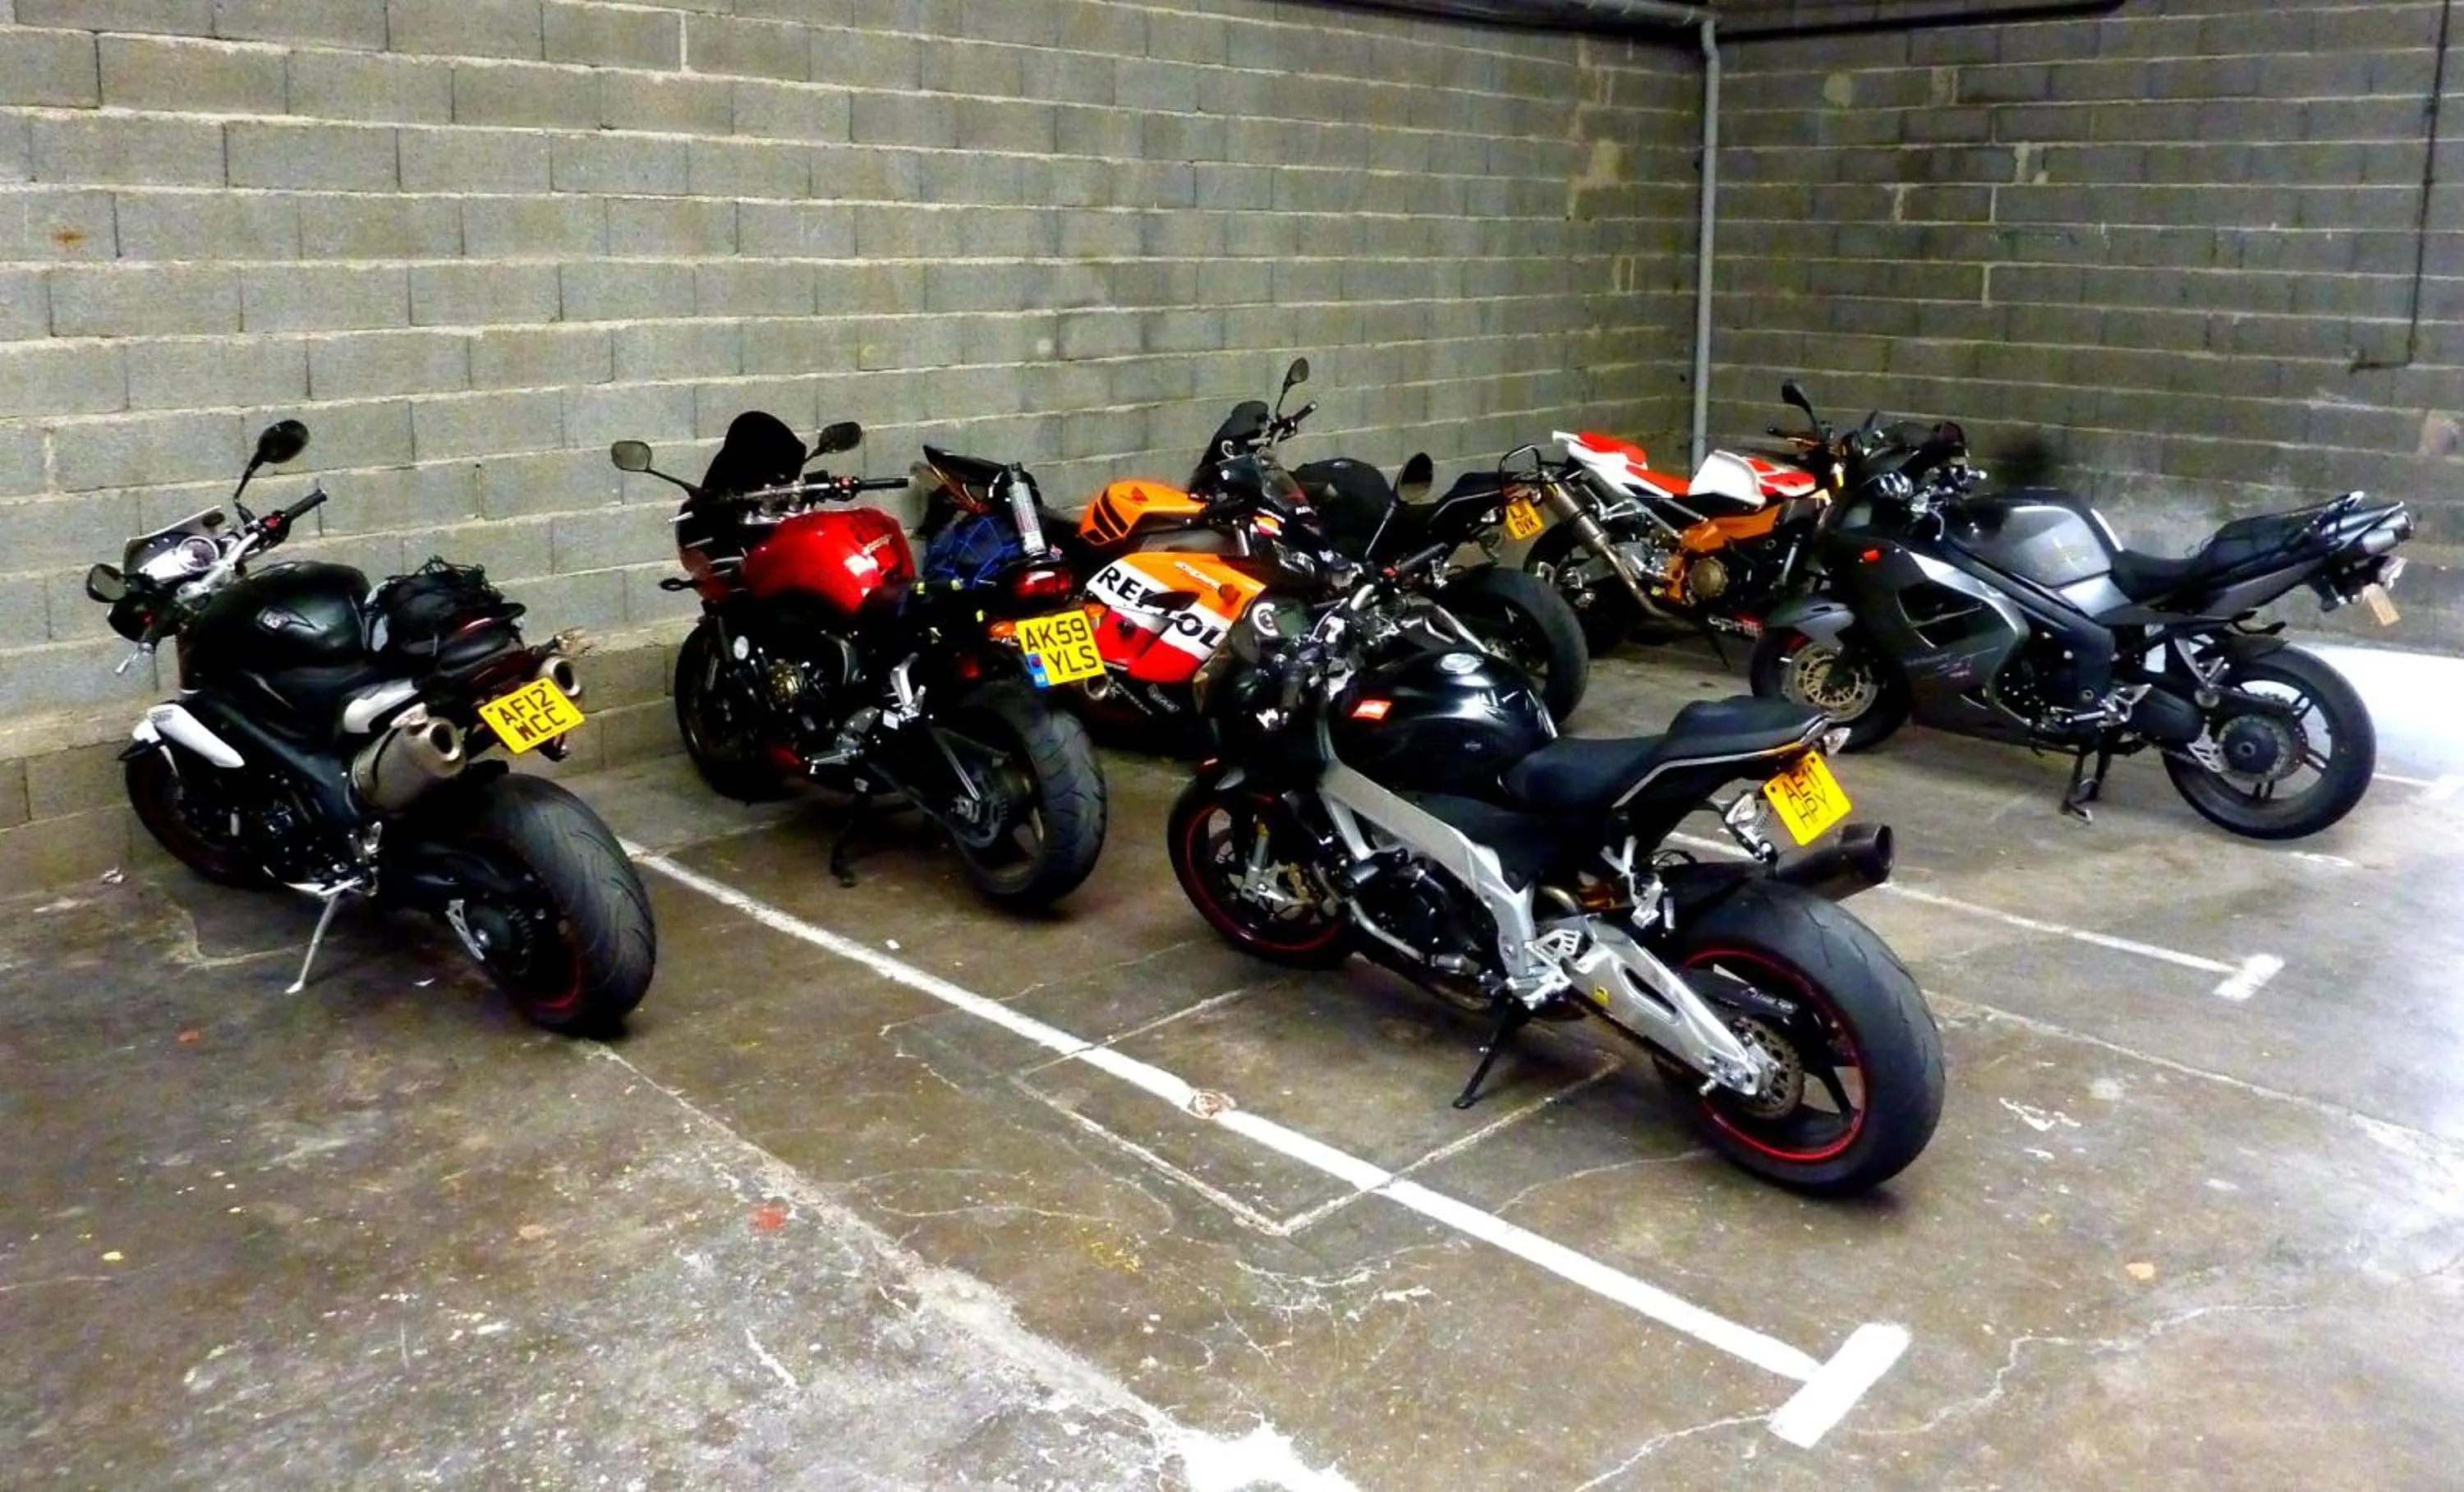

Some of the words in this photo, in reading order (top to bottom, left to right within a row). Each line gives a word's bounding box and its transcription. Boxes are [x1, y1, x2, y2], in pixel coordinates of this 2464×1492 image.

[1096, 566, 1221, 648] REOL
[1025, 618, 1087, 651] AK59
[1047, 645, 1097, 675] YLS
[498, 688, 554, 725] AF12
